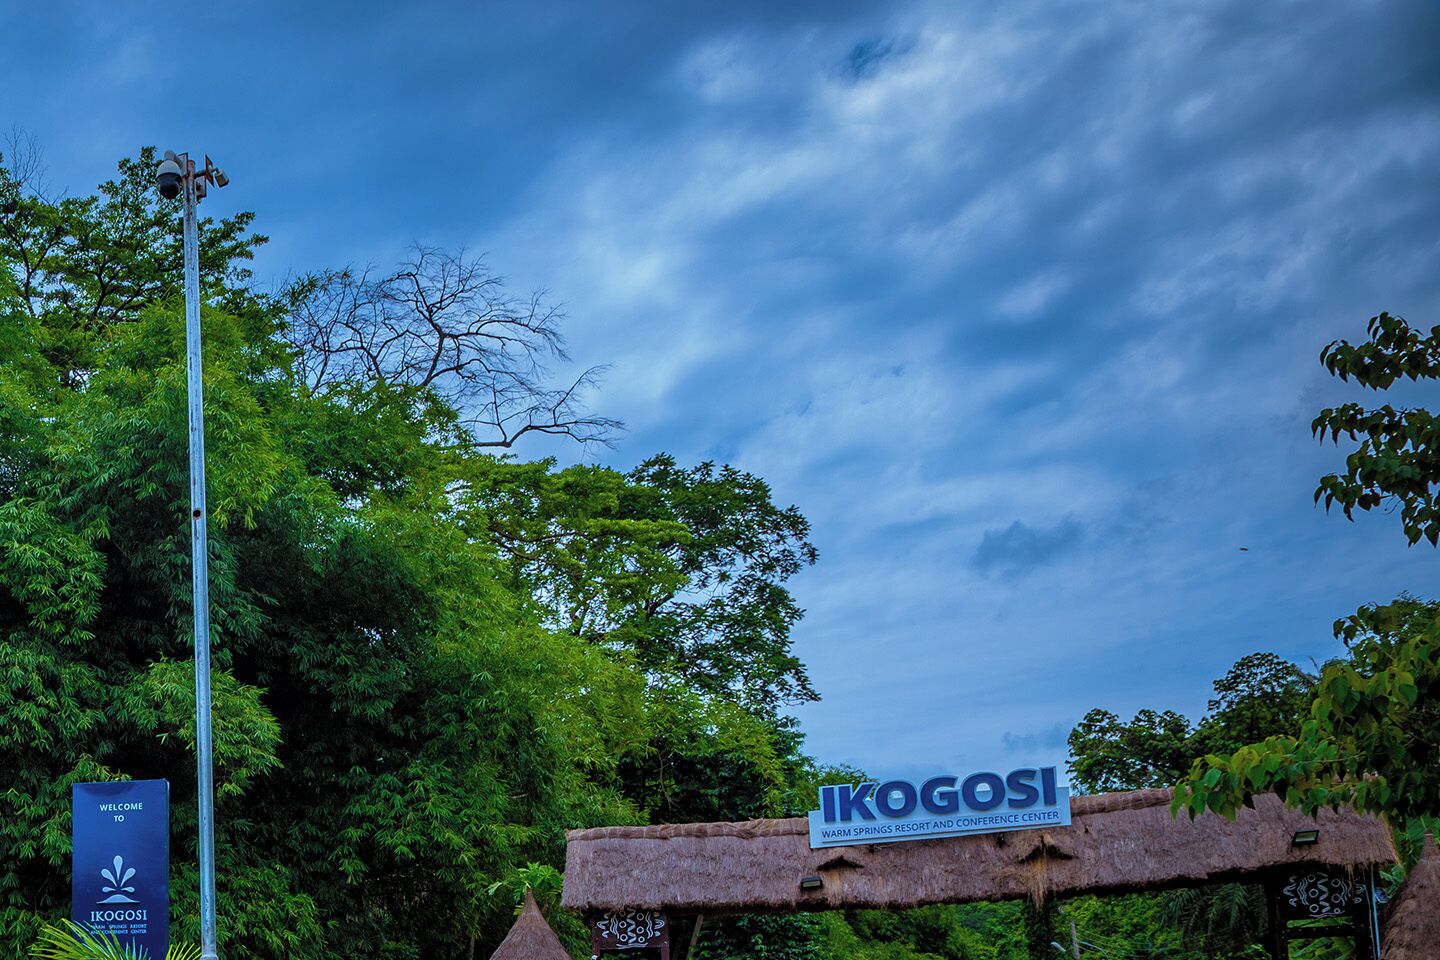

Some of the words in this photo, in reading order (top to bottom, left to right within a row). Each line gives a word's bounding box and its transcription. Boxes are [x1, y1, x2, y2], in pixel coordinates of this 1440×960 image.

[821, 766, 1057, 823] IKOGOSI
[100, 803, 143, 811] WELCOME
[822, 828, 851, 839] WARM
[853, 825, 893, 837] SPRINGS
[895, 821, 930, 833] RESORT
[932, 819, 954, 830] AND
[956, 815, 1020, 828] CONFERENCE
[1021, 810, 1060, 822] CENTER
[90, 910, 147, 921] IKOGOSI
